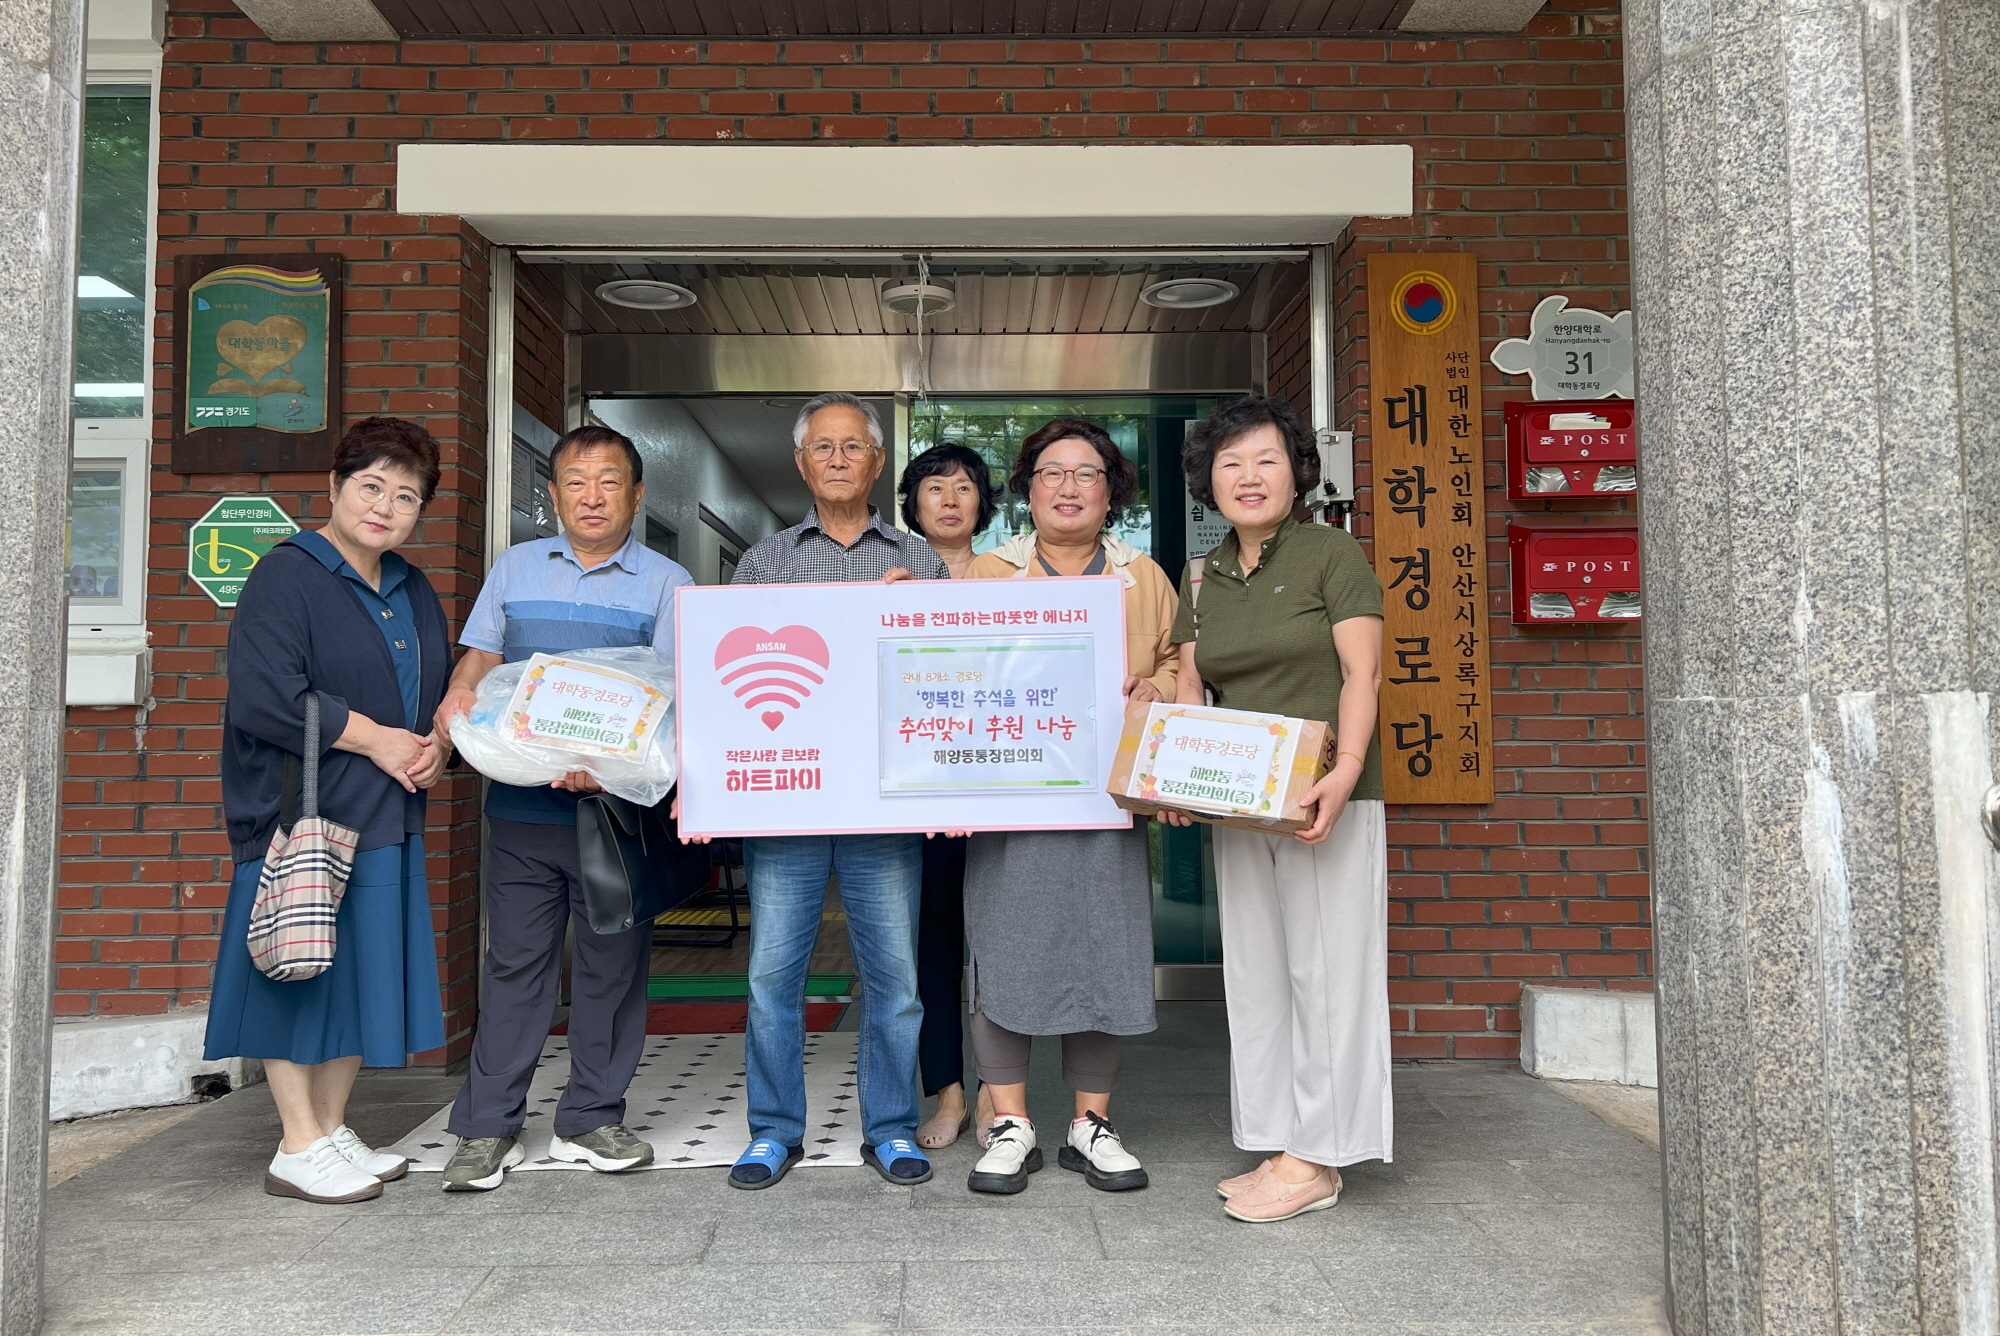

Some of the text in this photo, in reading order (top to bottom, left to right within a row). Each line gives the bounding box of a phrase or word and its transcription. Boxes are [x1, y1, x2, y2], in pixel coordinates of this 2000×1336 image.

[1553, 325, 1603, 336] 한양대학로
[228, 336, 292, 352] 대학동마을
[1545, 337, 1611, 346] Hanyangdaehak-ro
[1445, 351, 1471, 364] 사단
[1565, 351, 1594, 375] 31
[1445, 365, 1471, 379] 법인
[1557, 381, 1601, 391] 대학동경로당
[225, 406, 250, 417] 경기도
[1563, 434, 1628, 446] POST
[220, 509, 272, 519] 첨단무인경비
[1566, 560, 1631, 573] POST
[1383, 384, 1444, 778] 대학경로당
[219, 585, 243, 594] 495-
[881, 609, 1089, 628] 나눔을 전파하는따뜻한 에너지
[755, 642, 787, 653] ANSAN
[901, 671, 983, 684] 관내 8개소 경로당
[552, 681, 635, 707] 대학동경로당
[973, 688, 1016, 708] 추석을
[563, 707, 605, 725] 해양동
[898, 715, 1077, 743] 추석맞이 후원 나눔
[725, 748, 820, 763] 작은사랑 큰보람
[1174, 735, 1261, 761] 대학동경로당
[933, 748, 1044, 765] 해양동통장협의회
[726, 767, 821, 792] 하트파이
[1189, 765, 1233, 784] 해양동
